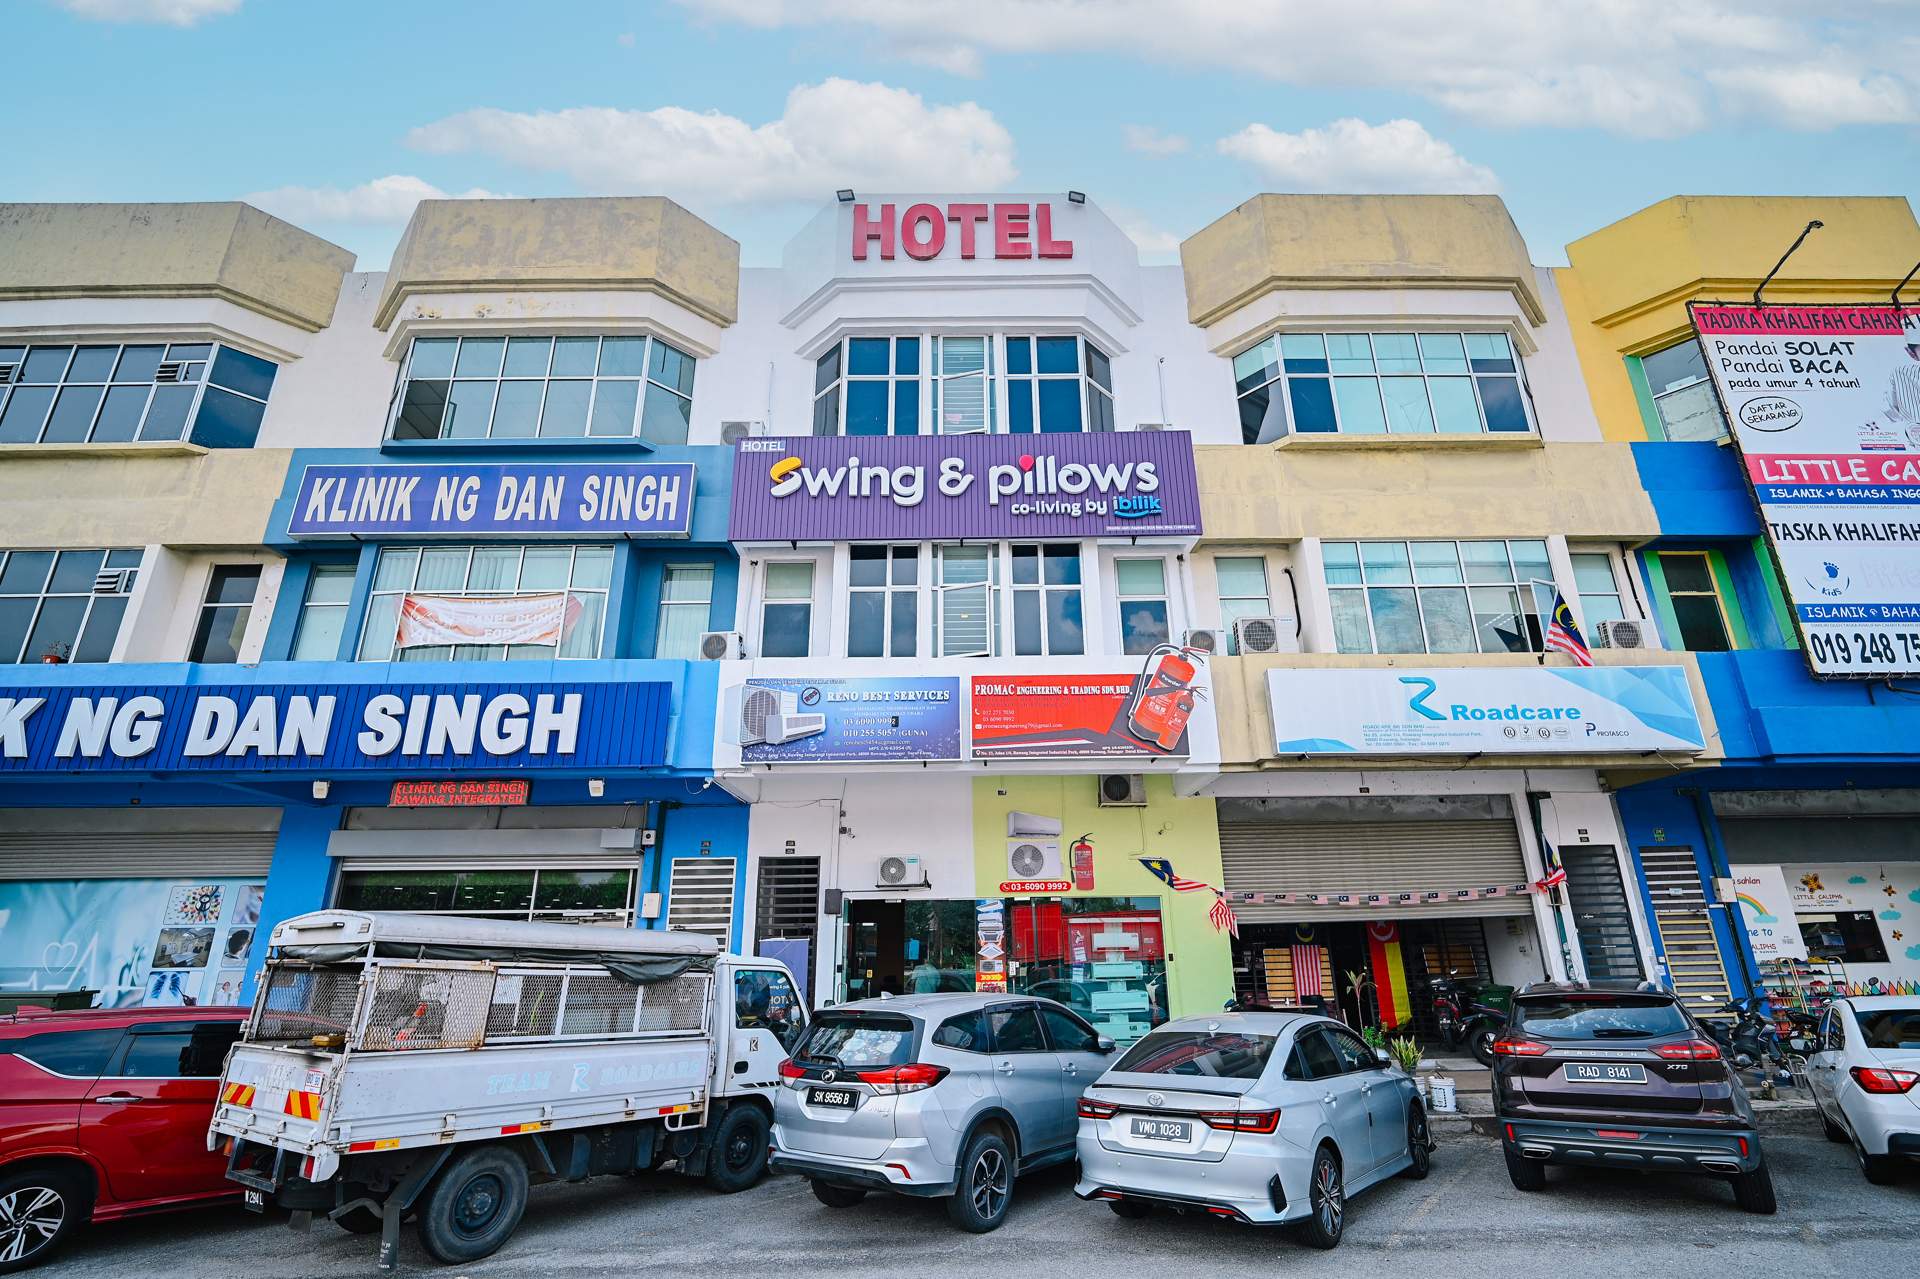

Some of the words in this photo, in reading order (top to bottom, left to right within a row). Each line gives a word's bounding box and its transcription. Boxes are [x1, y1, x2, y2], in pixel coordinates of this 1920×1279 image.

[852, 203, 1074, 260] HOTEL
[1700, 312, 1763, 330] TADIKA
[1764, 312, 1847, 330] KHALIFAH
[1848, 313, 1917, 330] CAHAYA
[1715, 340, 1778, 356] Pandai
[1784, 341, 1855, 356] SOLAT
[1721, 358, 1785, 374] Pandai
[1790, 359, 1849, 374] BACA
[1728, 378, 1761, 390] pada
[1765, 379, 1799, 388] umur
[1804, 377, 1814, 388] 4
[1818, 377, 1861, 389] tahun!
[1748, 402, 1788, 414] DAFTAR
[1747, 410, 1799, 424] SEKARANG!
[742, 441, 785, 451] HOTEL
[1759, 458, 1871, 481] LITTLE
[1881, 460, 1920, 481] CA
[769, 456, 924, 507] Swing
[938, 457, 974, 497] &
[988, 454, 1160, 506] pillows
[303, 477, 421, 522] KLINIK
[431, 475, 481, 521] NG
[494, 475, 566, 521] DAN
[579, 475, 681, 521] SINGH
[1769, 488, 1825, 498] ISLAMIK
[1836, 488, 1889, 498] BAHASA
[1011, 499, 1081, 518] co-living
[1085, 499, 1109, 515] by
[1770, 523, 1832, 541] TASKA
[1832, 523, 1920, 541] KHALIFAH
[1804, 607, 1868, 618] ISLAMIK
[1881, 606, 1920, 618] BAHA
[1811, 633, 1852, 664] 019
[1853, 633, 1897, 664] 248
[827, 691, 859, 702] RENO
[862, 691, 891, 701] BEST
[893, 690, 950, 701] SERVICES
[975, 684, 1015, 695] PROMAC
[1016, 685, 1062, 695] ENGINEERING
[1063, 685, 1069, 694] &
[1069, 685, 1100, 695] TRADING
[1450, 703, 1581, 721] Roadcare
[54, 695, 165, 758] NG
[183, 694, 336, 757] DAN
[358, 694, 583, 757] SINGH
[860, 729, 876, 737] 255
[877, 728, 897, 737] 5057
[439, 783, 457, 793] NG
[460, 783, 485, 793] DAN
[487, 782, 525, 793] SINGH
[1010, 882, 1045, 891] 03-6090
[1047, 881, 1068, 890] 9992
[1578, 1066, 1600, 1077] RAD
[1607, 1066, 1632, 1078] 8141
[813, 1090, 825, 1103] SK
[824, 1091, 844, 1105] 9556
[843, 1093, 850, 1105] B
[1138, 1121, 1156, 1135] VMQ
[1160, 1123, 1182, 1137] 1028
